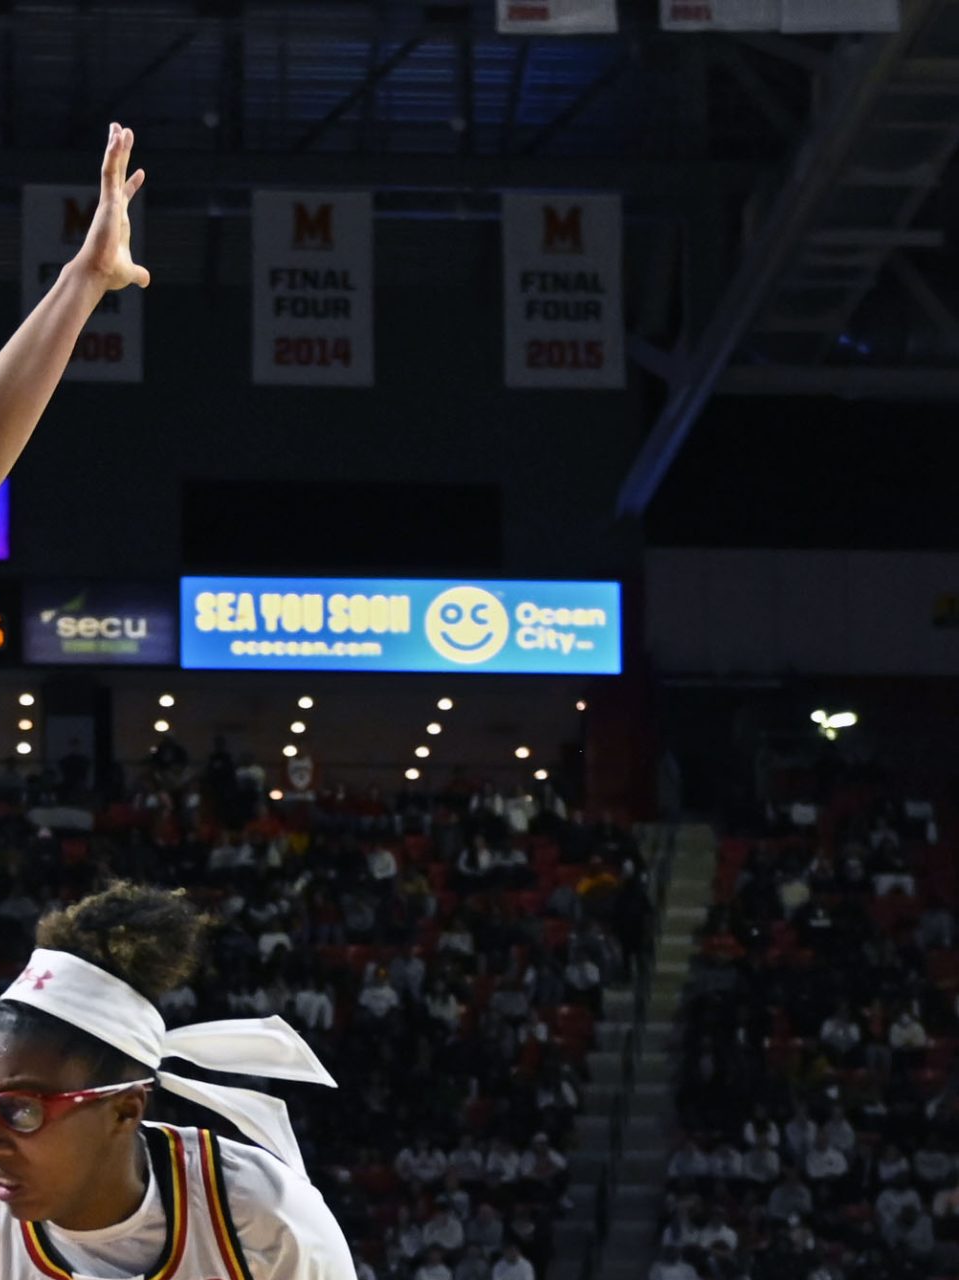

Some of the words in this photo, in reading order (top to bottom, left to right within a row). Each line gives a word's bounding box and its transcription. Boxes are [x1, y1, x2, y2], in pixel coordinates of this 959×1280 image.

[294, 203, 333, 248] M
[543, 206, 583, 250] M
[269, 269, 357, 291] FINAL
[520, 271, 606, 294] FINAL
[273, 296, 352, 320] FOUR
[525, 299, 602, 323] FOUR
[274, 337, 353, 367] 2014
[525, 340, 604, 370] 2015
[194, 592, 257, 632] SEA
[261, 593, 323, 633] YOU
[327, 594, 411, 634] SOON
[515, 602, 606, 627] Ocean
[56, 616, 147, 639] secu
[515, 627, 577, 655] City
